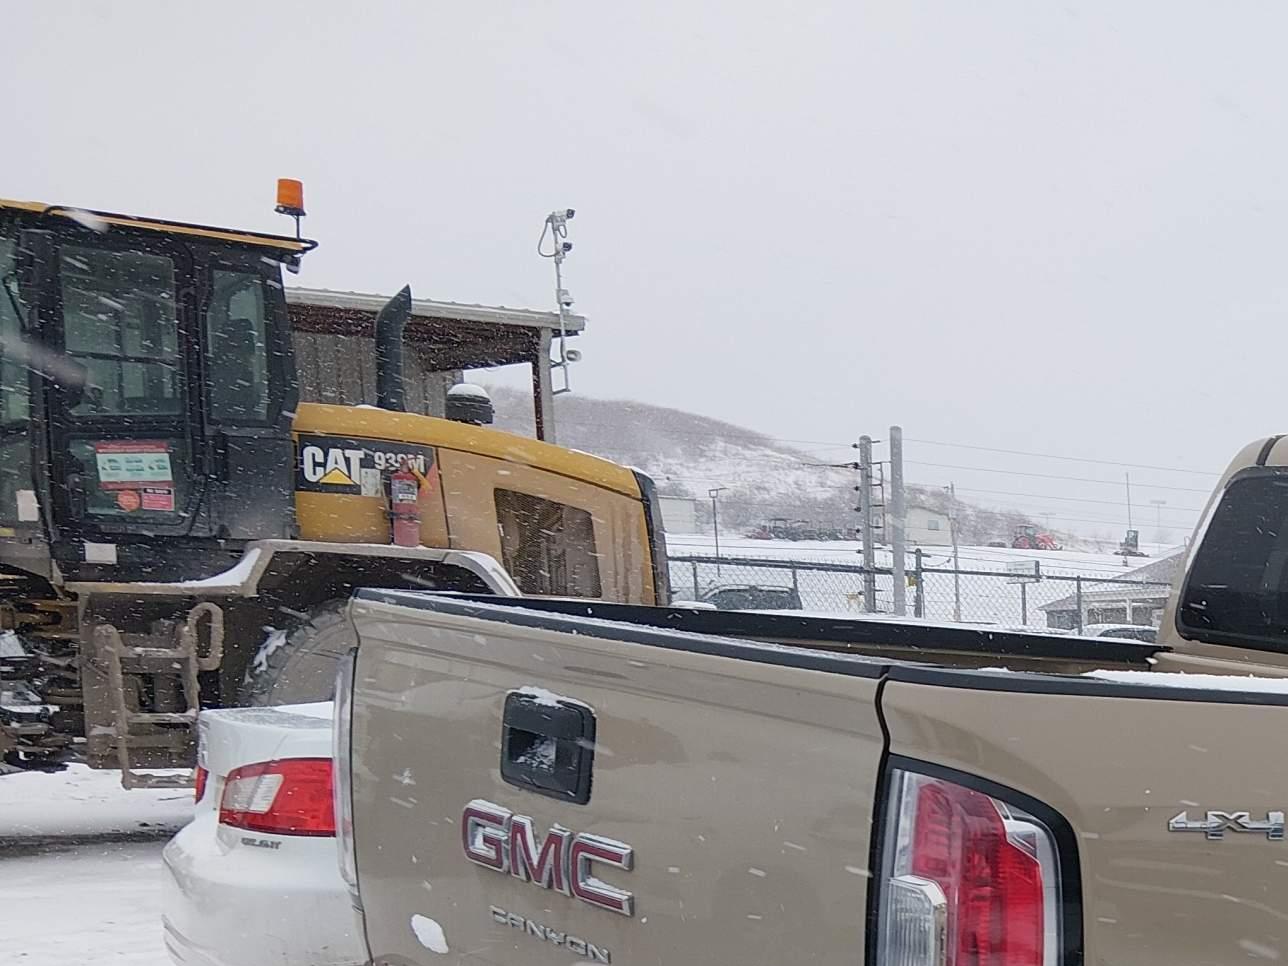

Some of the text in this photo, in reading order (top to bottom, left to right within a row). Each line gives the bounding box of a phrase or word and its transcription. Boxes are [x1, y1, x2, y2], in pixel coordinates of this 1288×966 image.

[302, 445, 364, 486] CAT
[462, 799, 634, 918] GMC
[489, 905, 612, 964] CANYON
